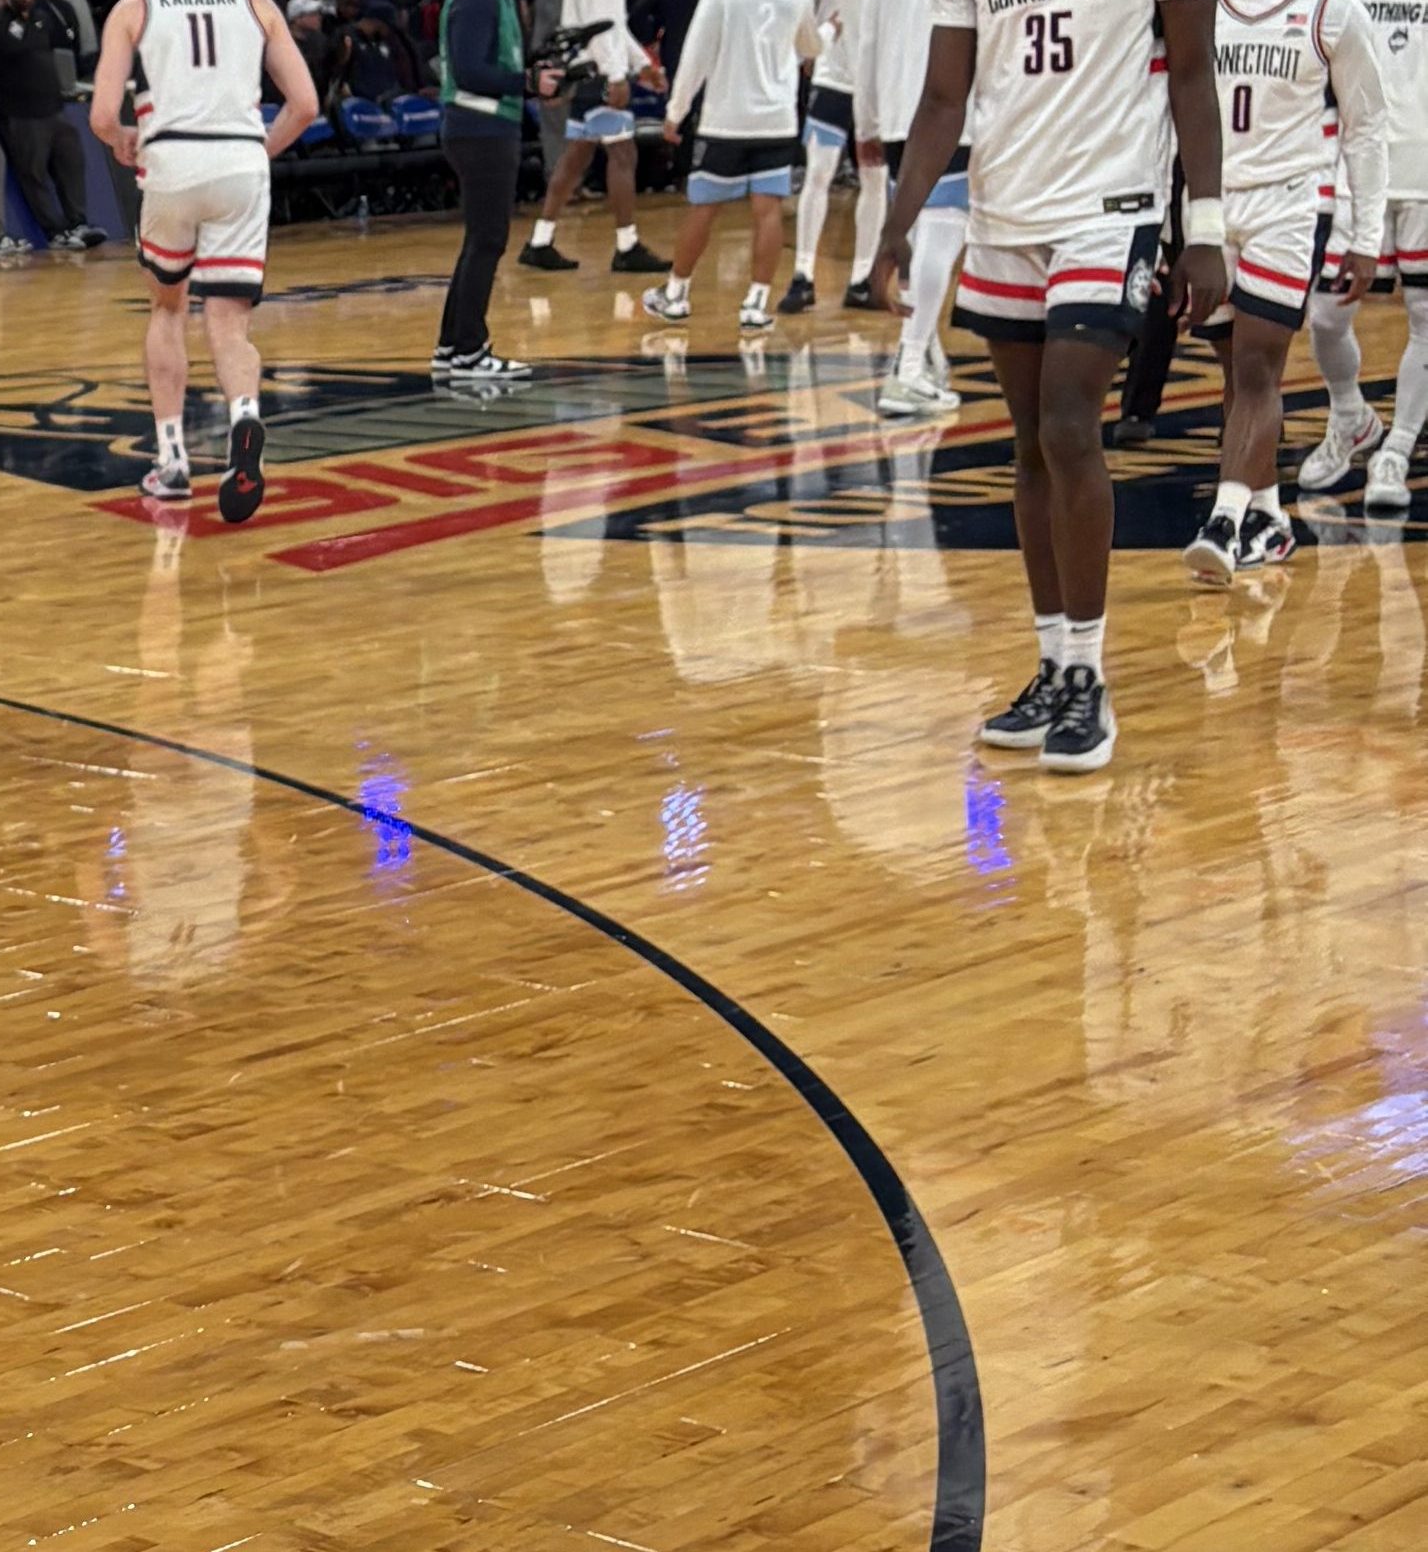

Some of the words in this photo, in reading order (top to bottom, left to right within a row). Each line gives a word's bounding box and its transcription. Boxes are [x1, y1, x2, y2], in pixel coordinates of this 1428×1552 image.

[186, 12, 217, 68] 11
[1024, 10, 1074, 75] 35
[1232, 85, 1253, 134] 0
